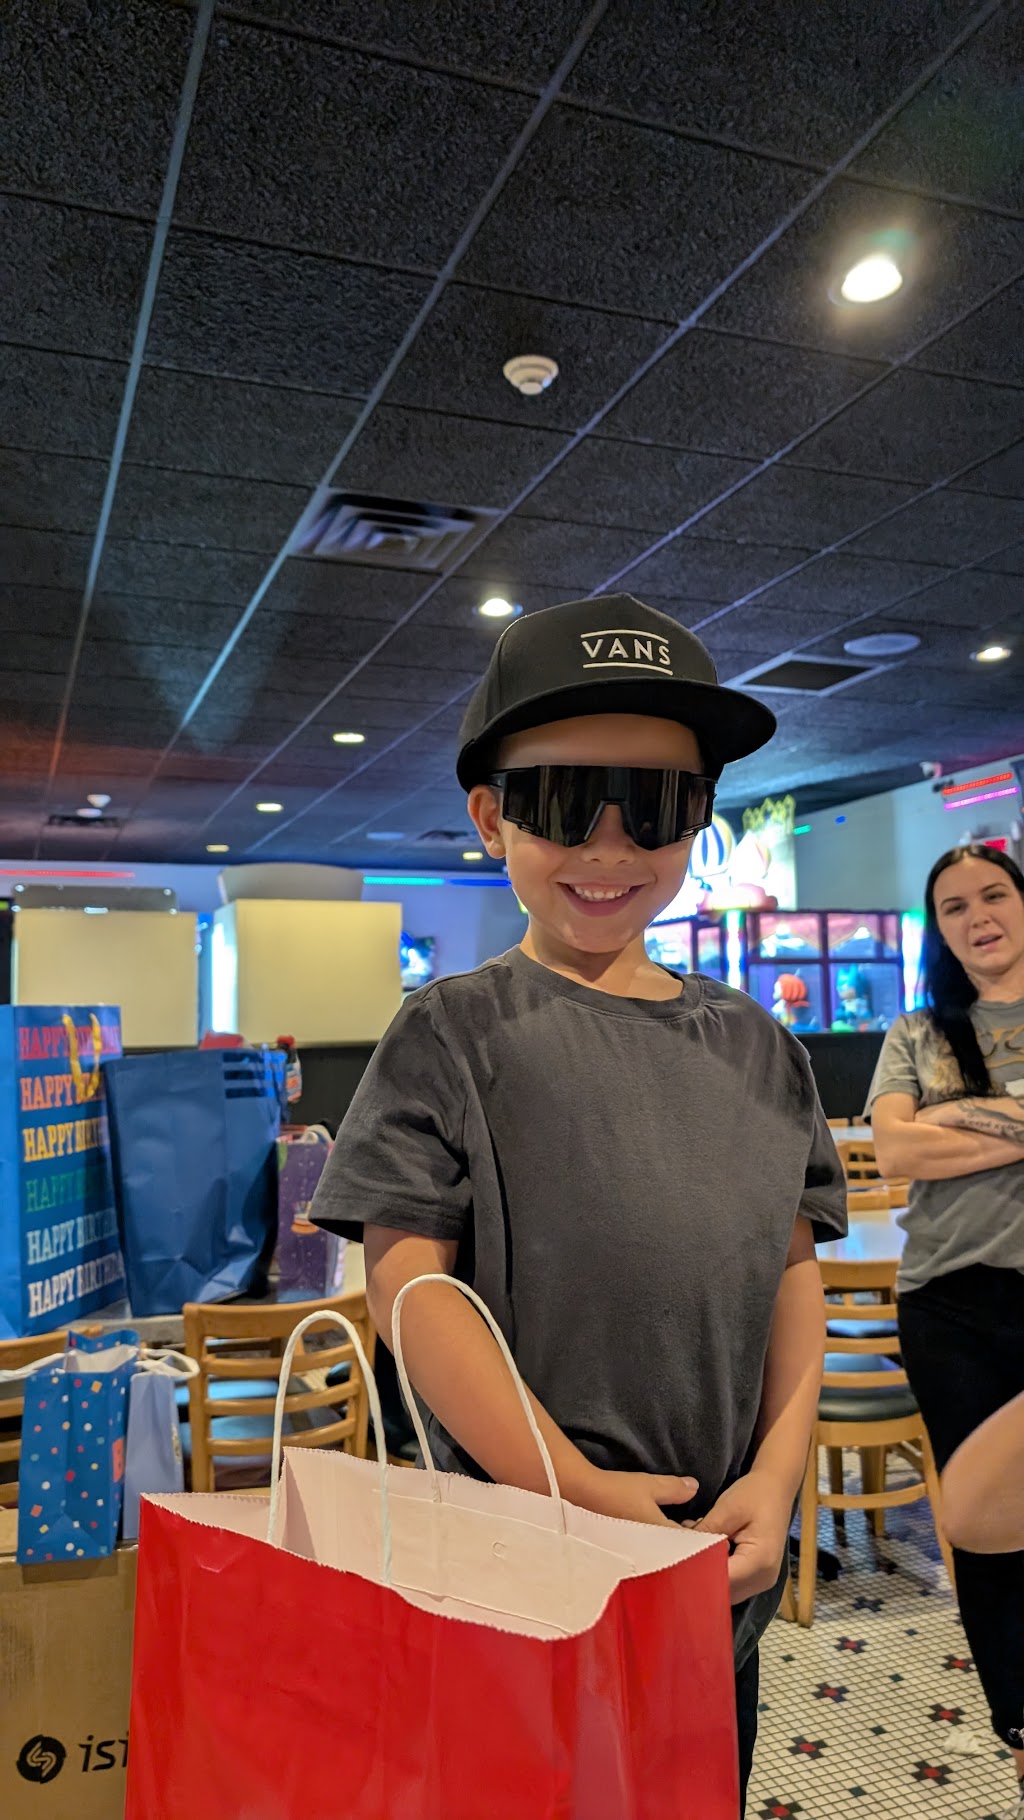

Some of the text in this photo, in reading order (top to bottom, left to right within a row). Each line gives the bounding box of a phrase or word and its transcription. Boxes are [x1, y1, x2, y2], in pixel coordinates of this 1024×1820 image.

[582, 637, 671, 666] VANS
[18, 1026, 71, 1060] HAPPY
[20, 1074, 73, 1111] HAPPY
[22, 1122, 74, 1163] HAPPY
[25, 1171, 75, 1214] HAPPY
[26, 1219, 75, 1266] HAPPY
[28, 1267, 76, 1319] HAPPY
